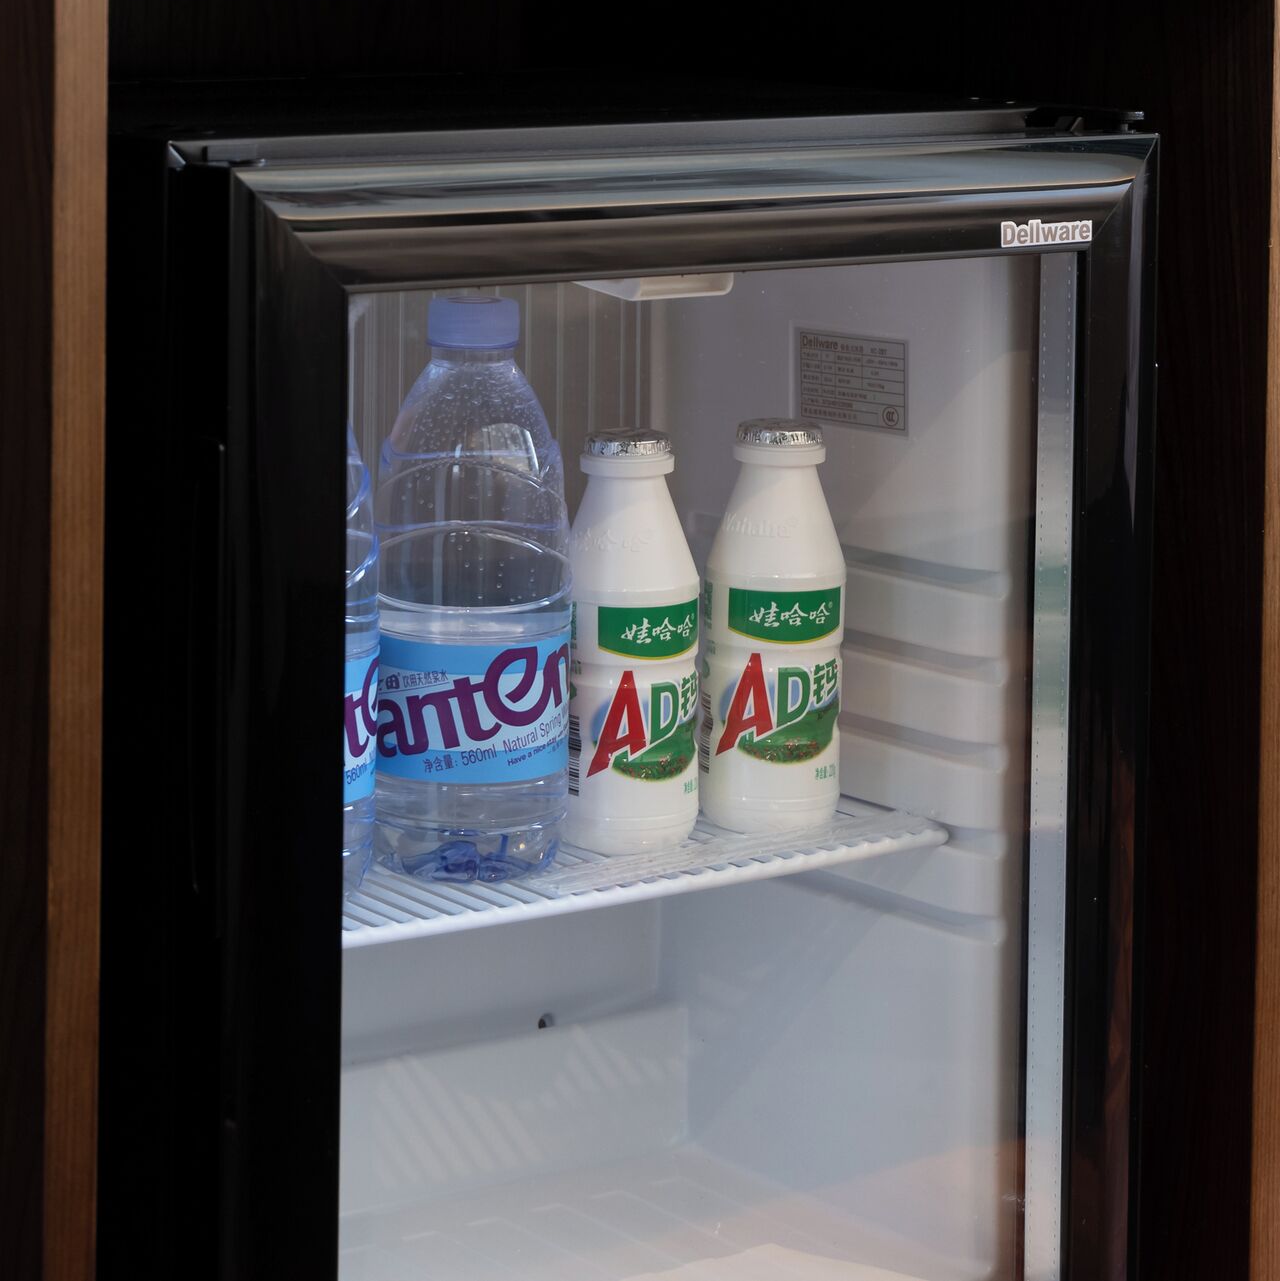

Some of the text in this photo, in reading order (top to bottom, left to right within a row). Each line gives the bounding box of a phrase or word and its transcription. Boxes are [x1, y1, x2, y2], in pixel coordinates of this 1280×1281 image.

[1002, 221, 1091, 247] Dellware
[750, 601, 830, 628] 娃哈哈
[621, 617, 693, 645] 娃哈哈
[503, 726, 538, 754] Natural
[461, 744, 497, 767] 560ml
[507, 754, 527, 767] Have
